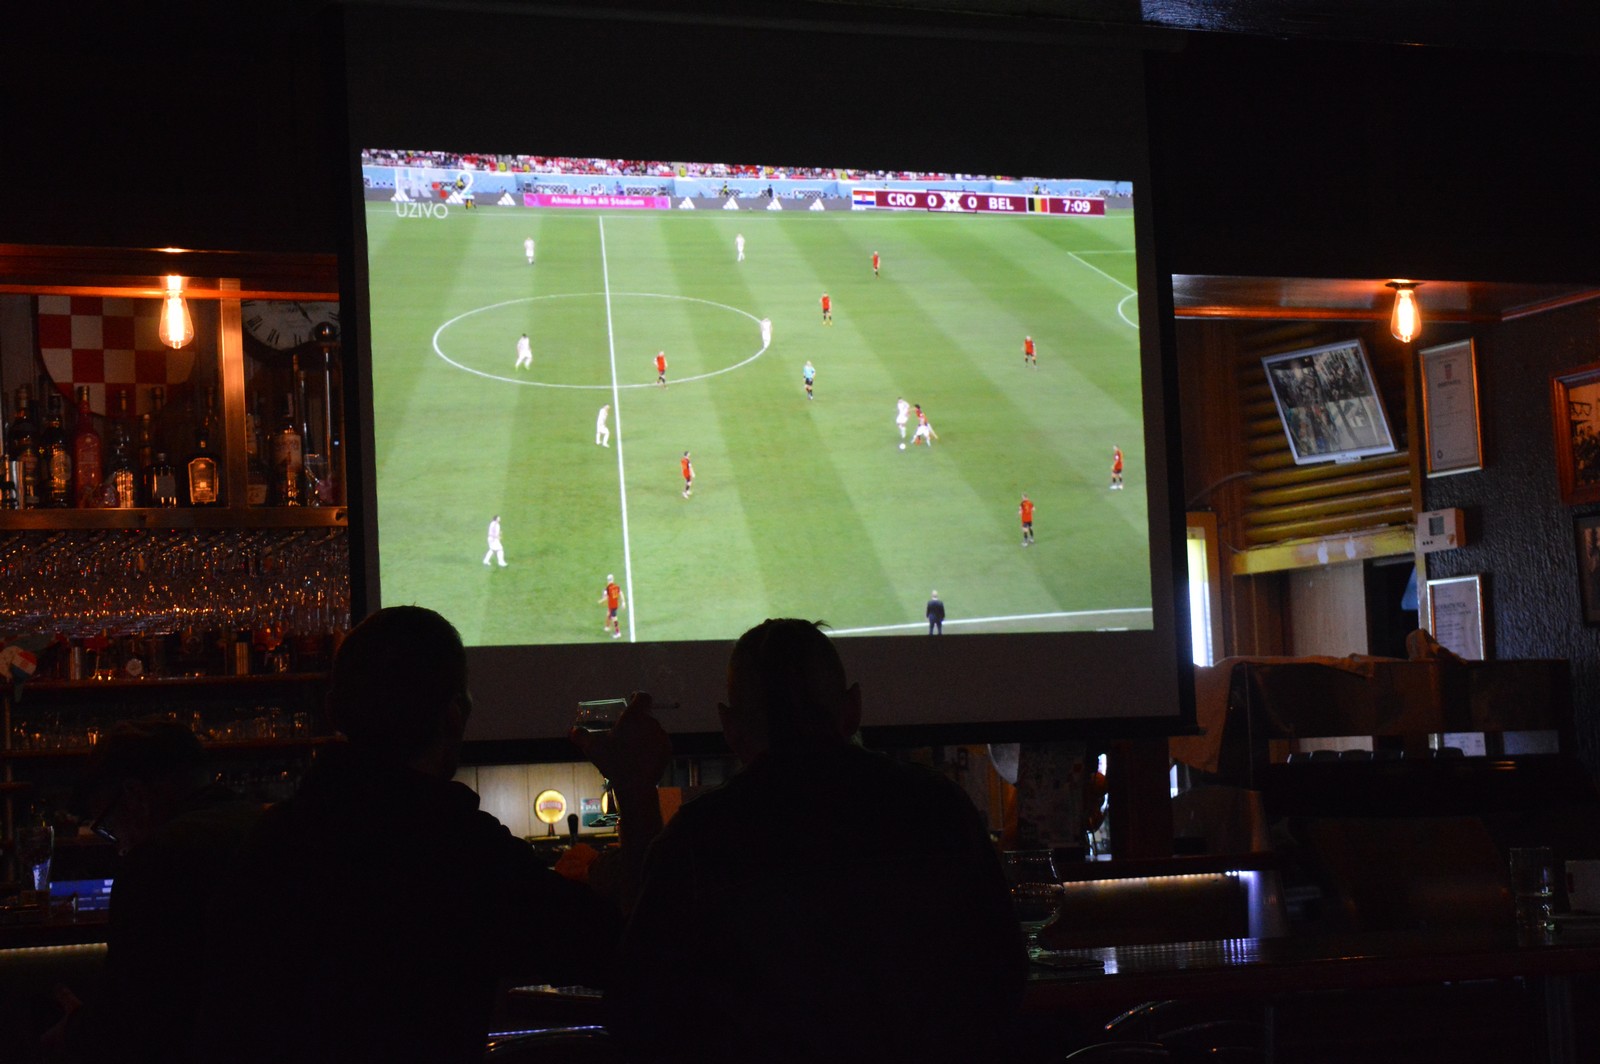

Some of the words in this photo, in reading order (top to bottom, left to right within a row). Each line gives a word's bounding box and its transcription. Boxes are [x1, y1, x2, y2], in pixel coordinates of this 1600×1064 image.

[583, 196, 597, 205] Bin
[598, 197, 609, 205] Ali
[610, 197, 645, 206] Stadium
[887, 193, 916, 206] CRO
[927, 194, 937, 207] 0
[968, 196, 977, 208] 0
[988, 197, 1014, 210] BEL
[1062, 200, 1091, 213] 7:09
